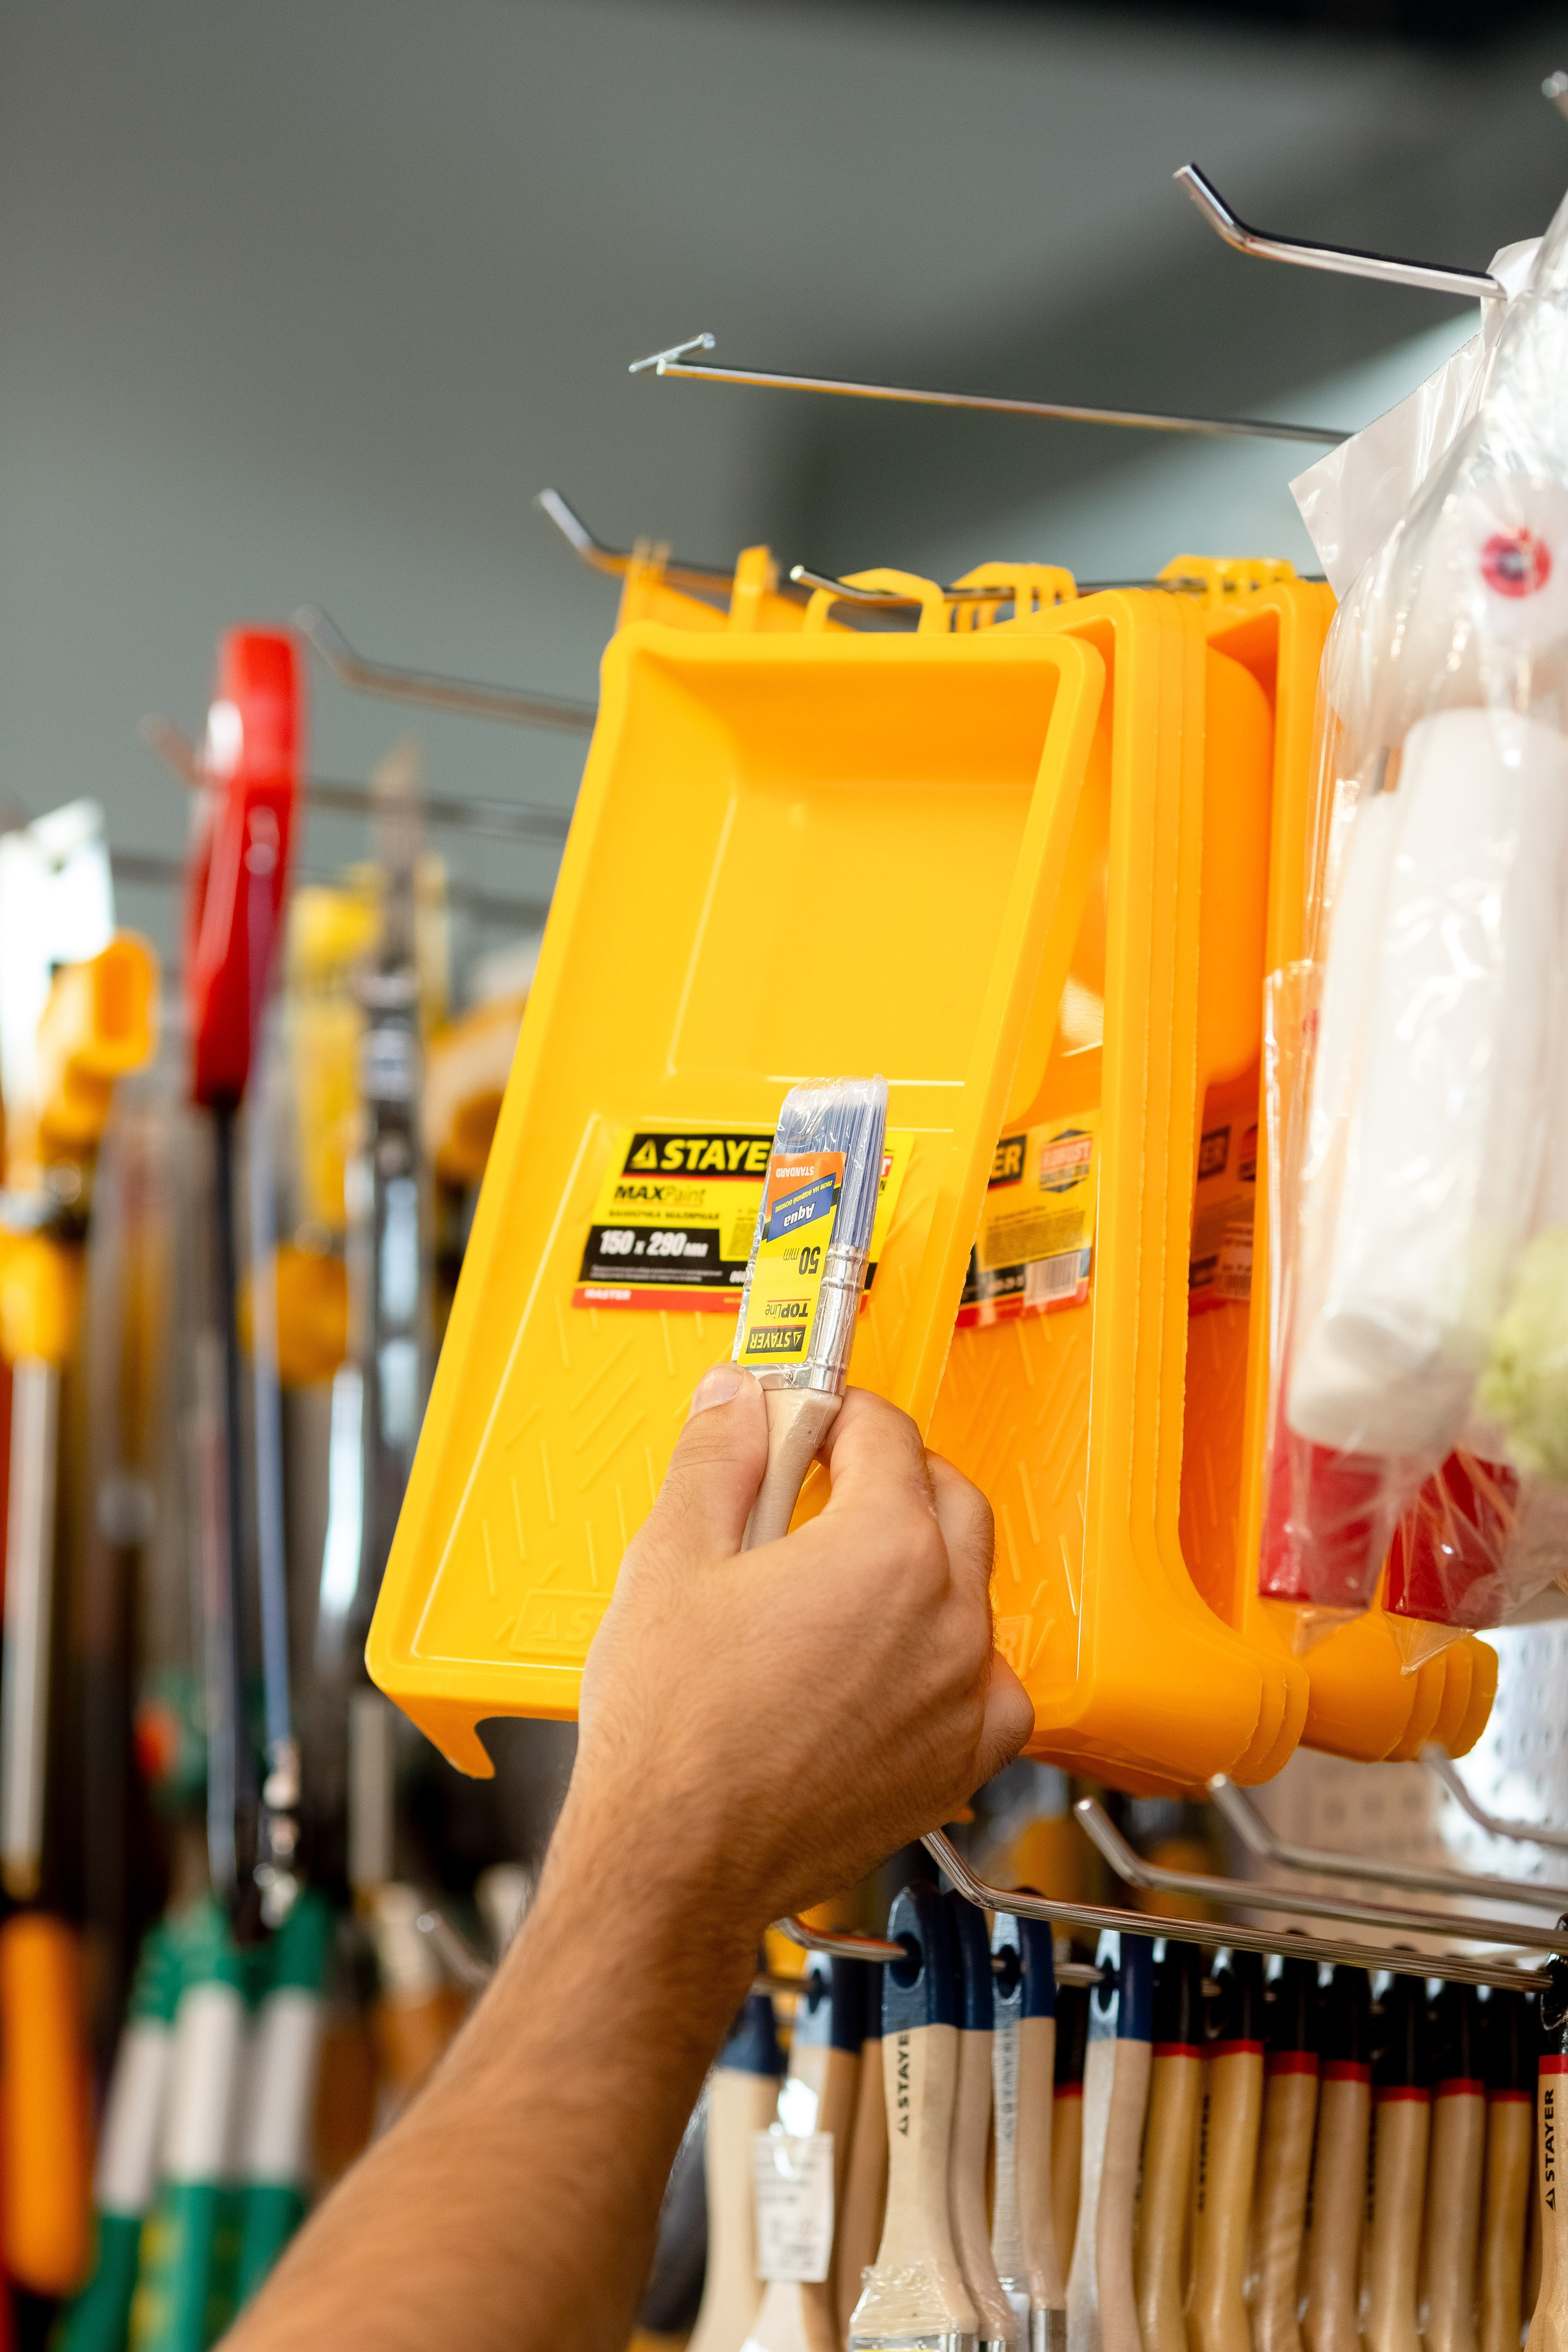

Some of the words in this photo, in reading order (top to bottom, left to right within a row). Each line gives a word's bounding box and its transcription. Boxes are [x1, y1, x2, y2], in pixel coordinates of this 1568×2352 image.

[660, 1139, 772, 1171] STAYE
[775, 1166, 815, 1178] STANDARD
[793, 1189, 812, 1205] ВОДНОЙ
[784, 1202, 816, 1227] Aqua
[599, 1229, 636, 1256] 150
[799, 1246, 821, 1275] 50
[749, 1331, 792, 1349] STAYER
[897, 2034, 910, 2109] STAYE
[1544, 2088, 1555, 2182] STAYER
